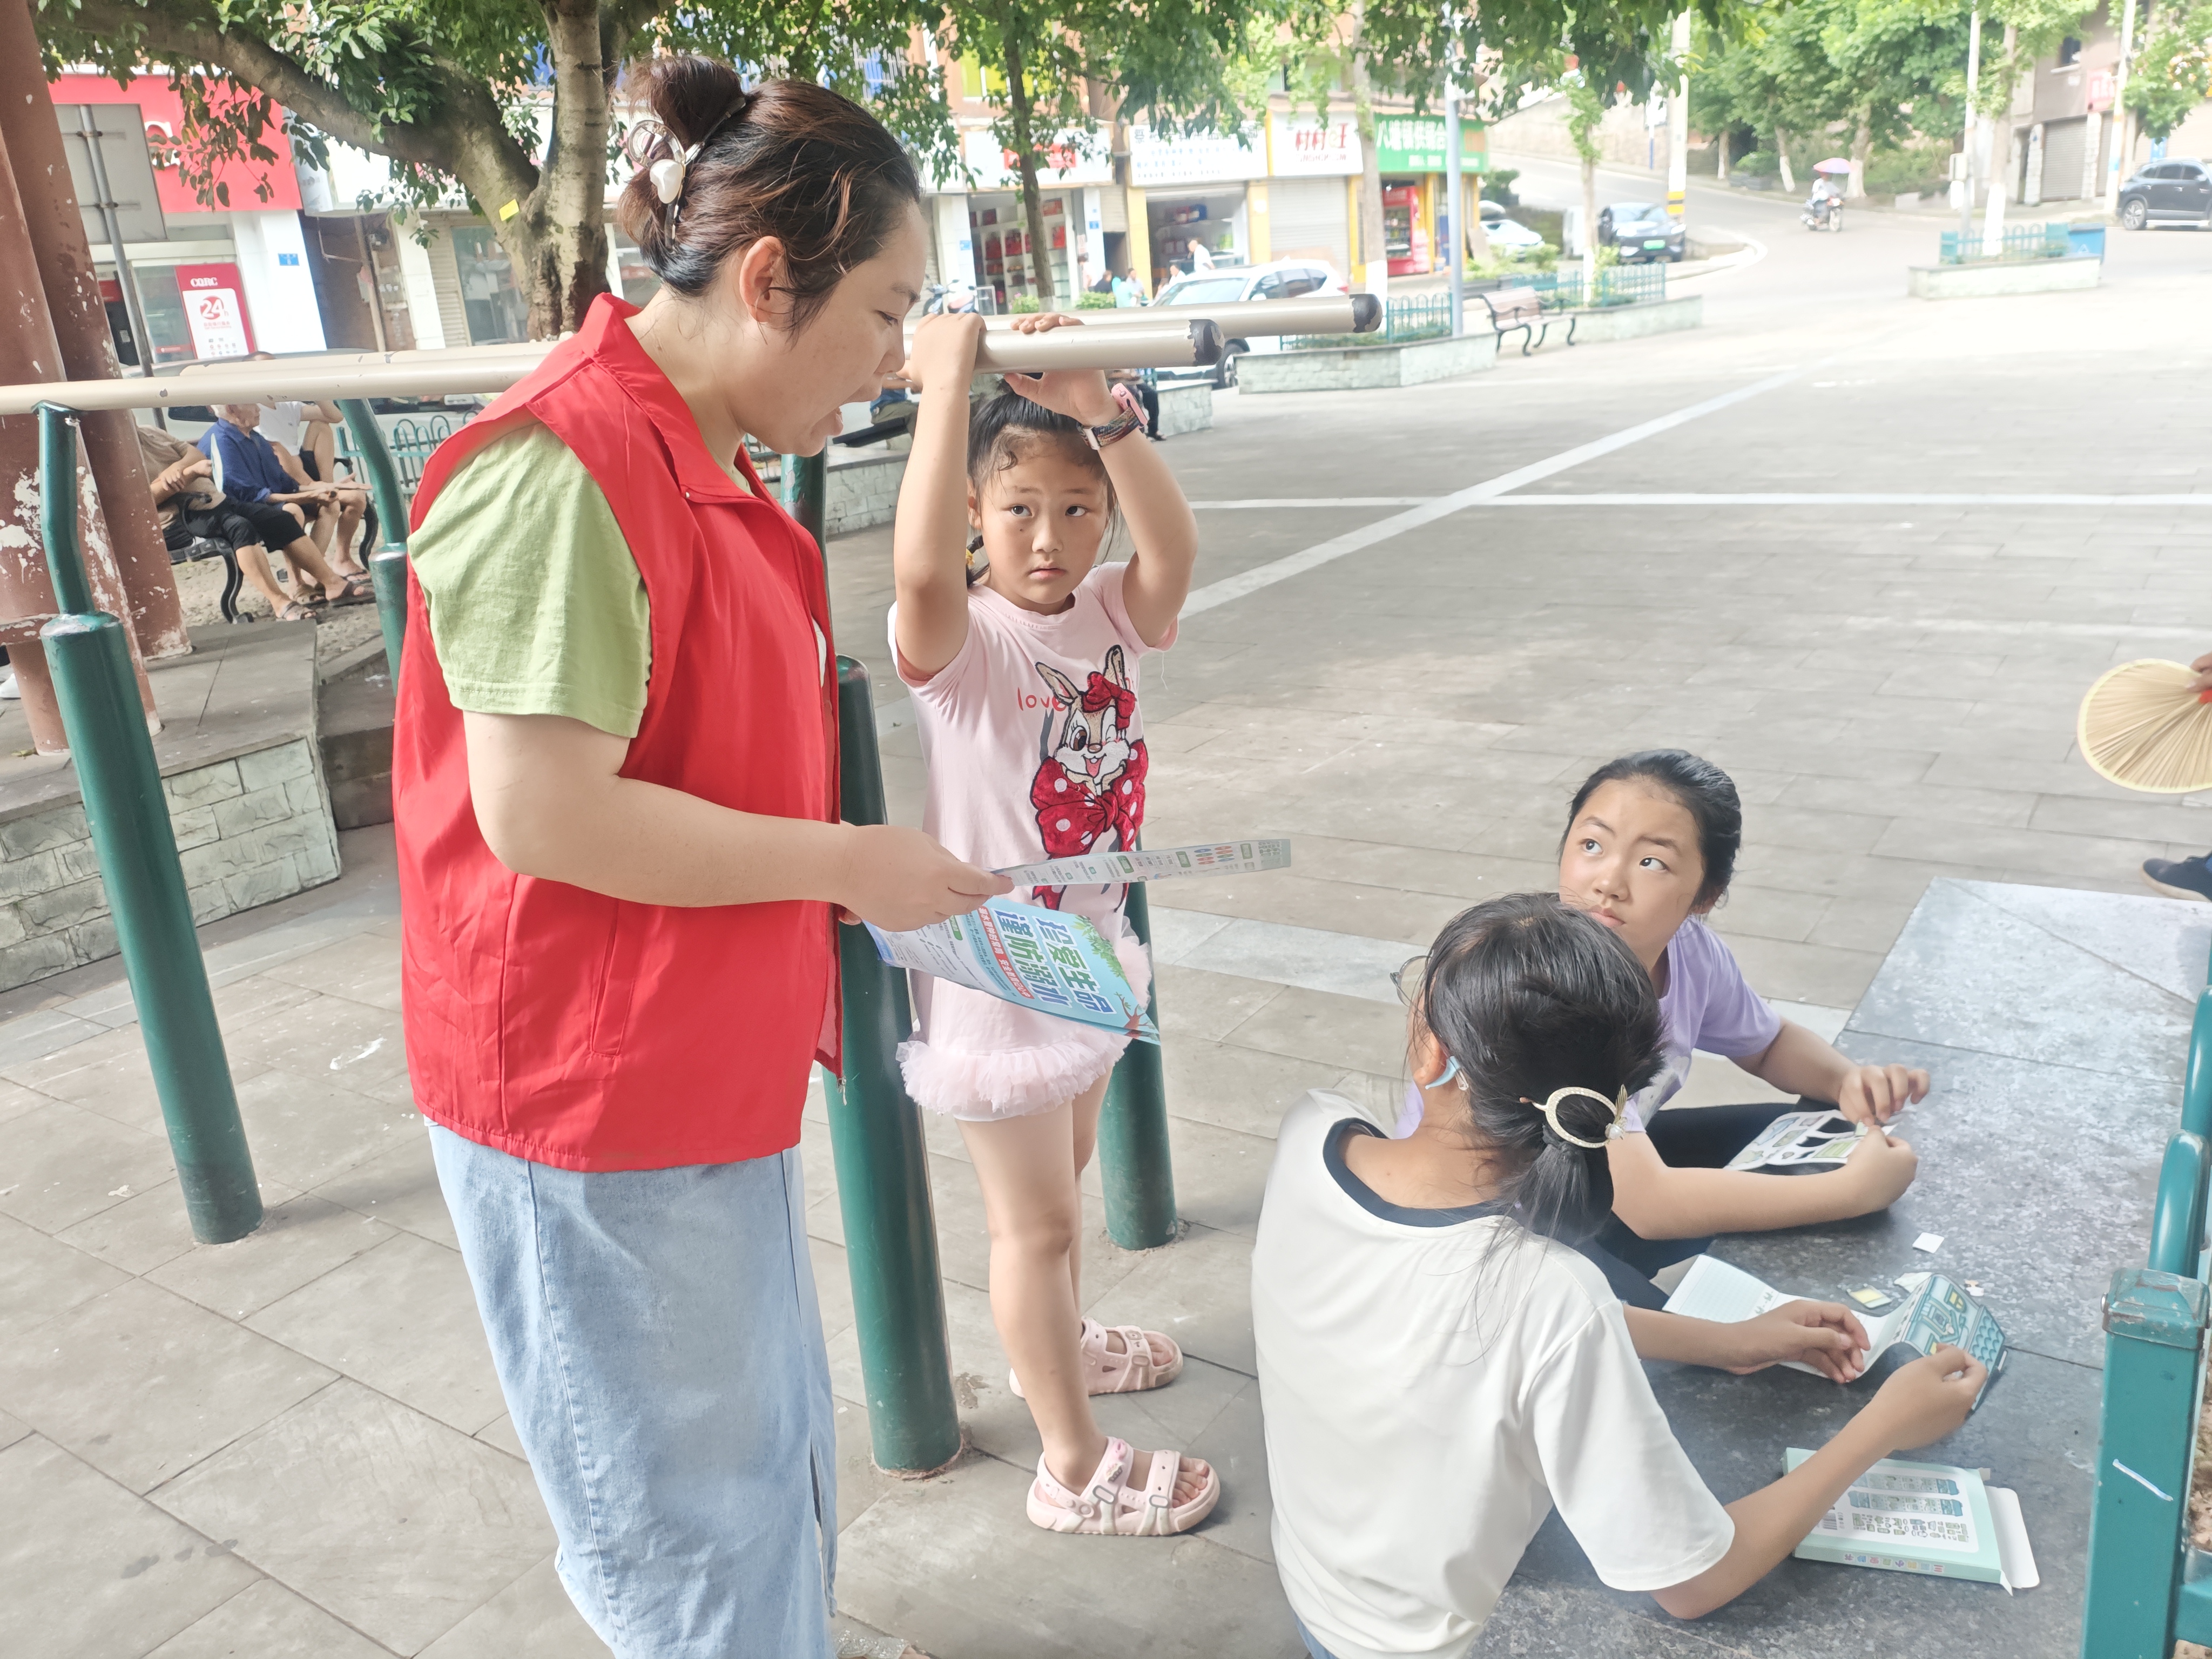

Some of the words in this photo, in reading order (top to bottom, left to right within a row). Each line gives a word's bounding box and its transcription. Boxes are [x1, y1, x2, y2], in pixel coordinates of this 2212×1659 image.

[1017, 686, 1067, 712] love
[994, 909, 1069, 1006] 谨防溺水
[999, 959, 1031, 997] 安全教育记心中
[1035, 917, 1115, 1014] 珍爱生命
